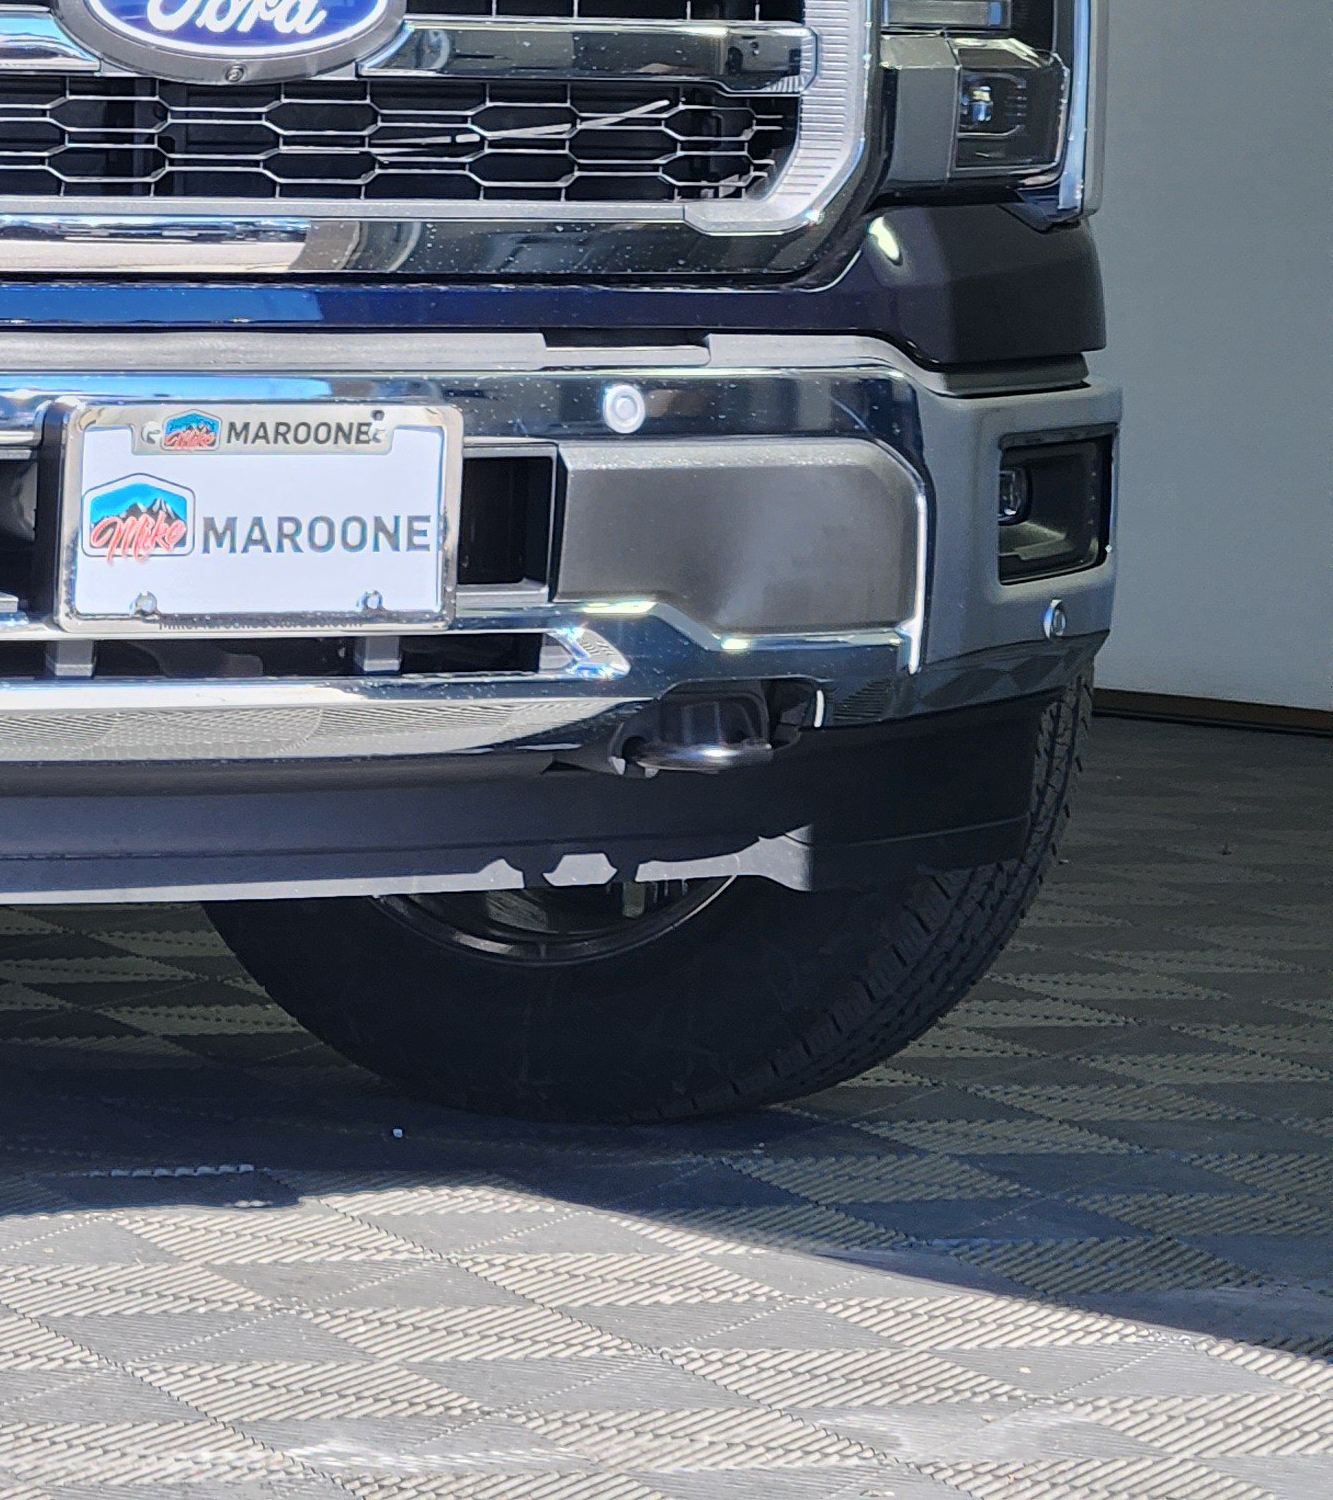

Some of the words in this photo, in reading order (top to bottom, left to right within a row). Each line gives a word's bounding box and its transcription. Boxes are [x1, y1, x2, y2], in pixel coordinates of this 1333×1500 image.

[227, 421, 371, 445] MAROONE
[91, 512, 187, 562] Mike
[202, 514, 431, 554] MAROONE
